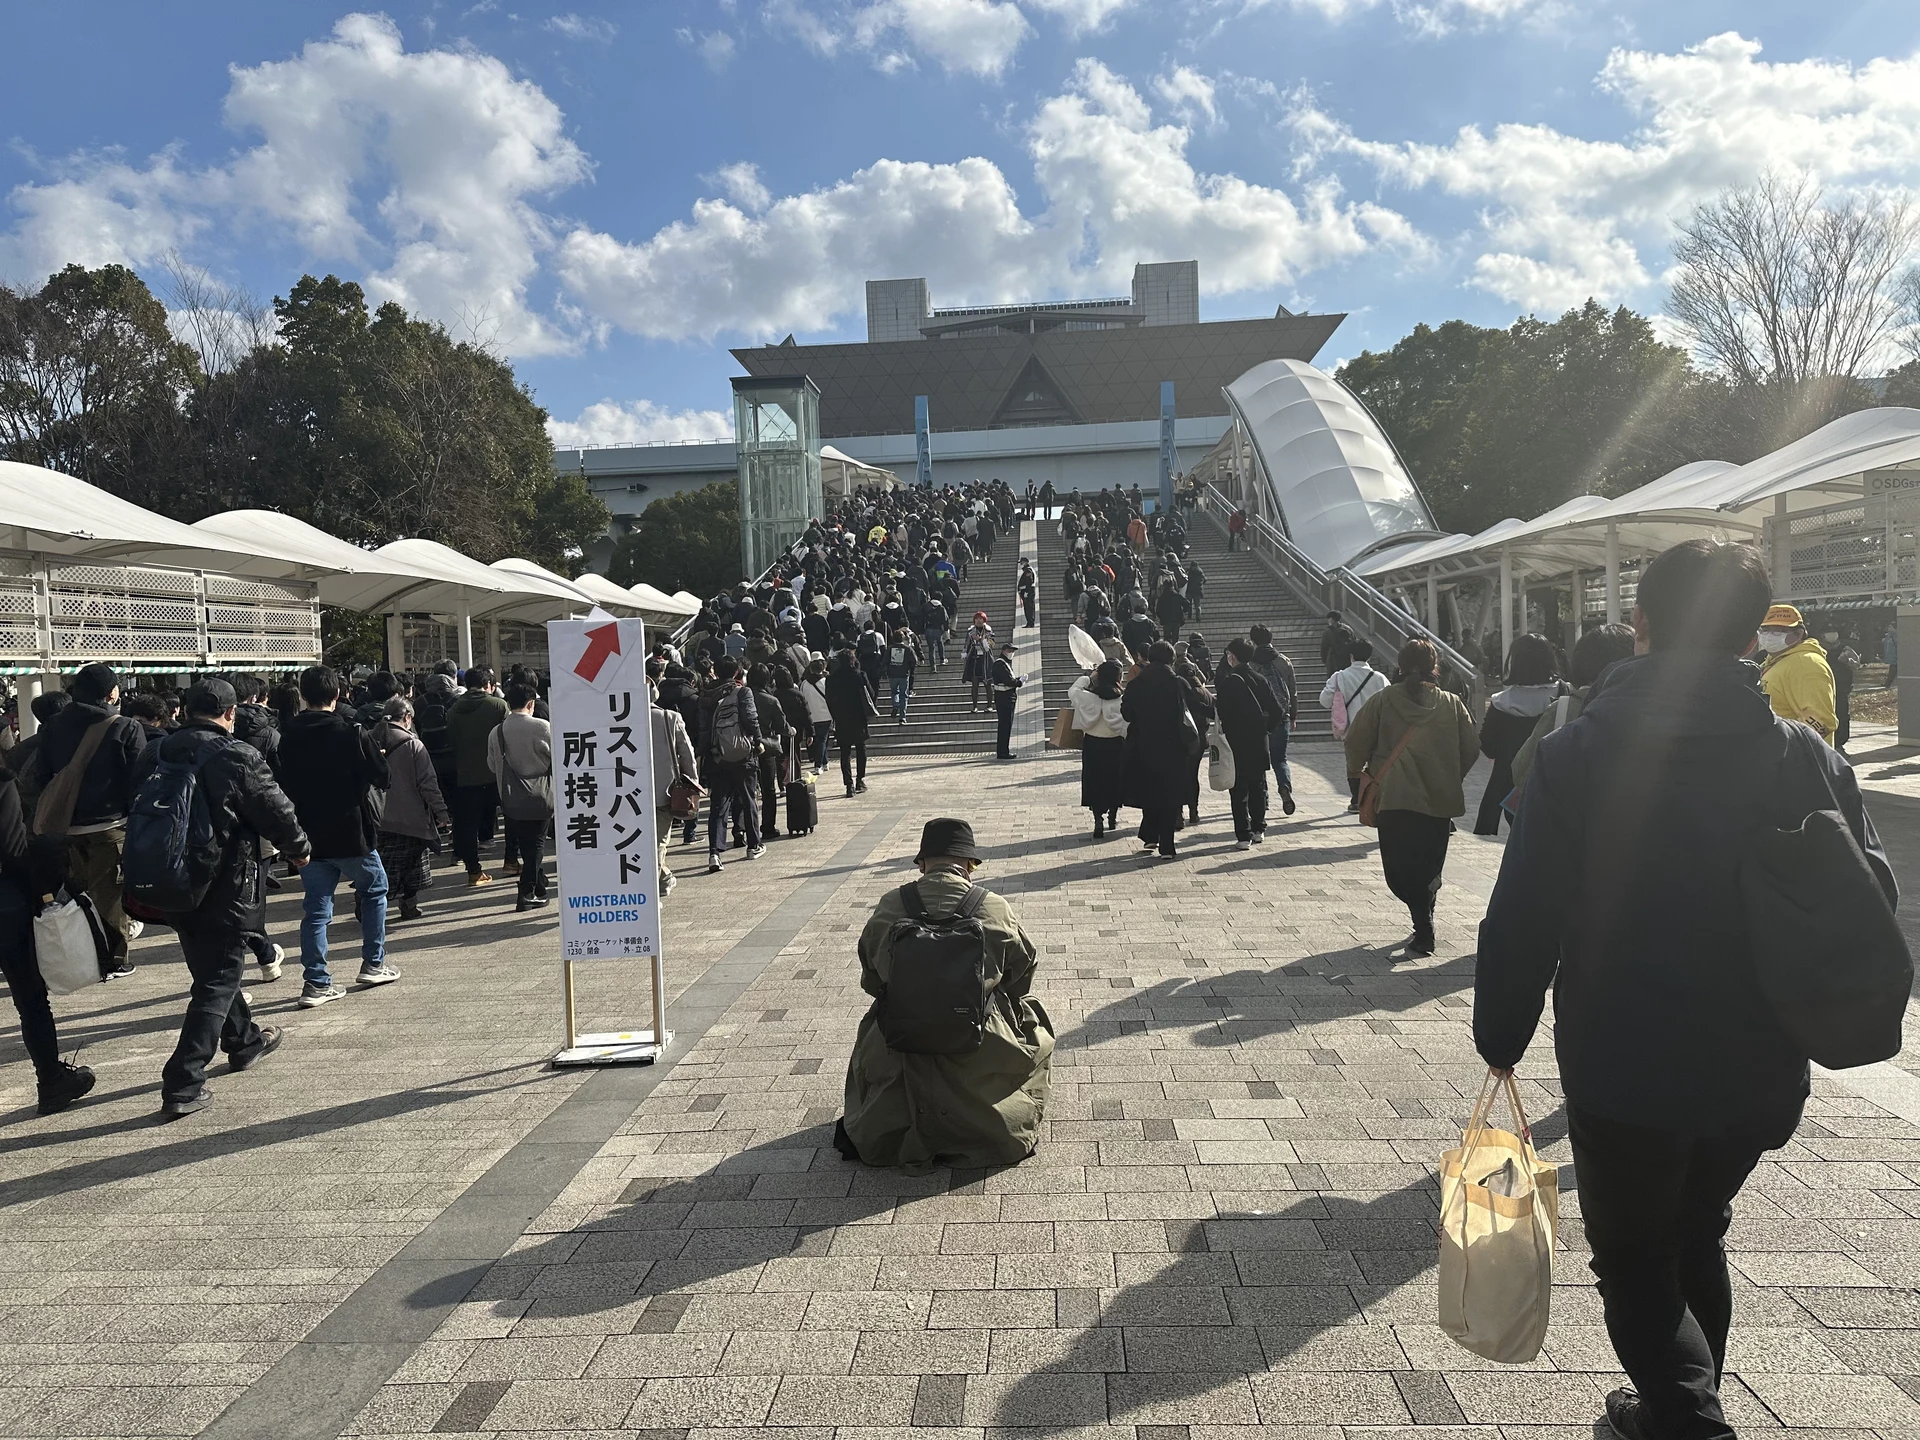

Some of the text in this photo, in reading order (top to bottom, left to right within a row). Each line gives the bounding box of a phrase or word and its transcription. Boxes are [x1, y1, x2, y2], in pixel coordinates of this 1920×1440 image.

[563, 731, 600, 849] 所持者
[607, 692, 642, 885] リストバンド
[568, 893, 647, 908] WRISTBAND
[579, 909, 639, 924] HOLDERS
